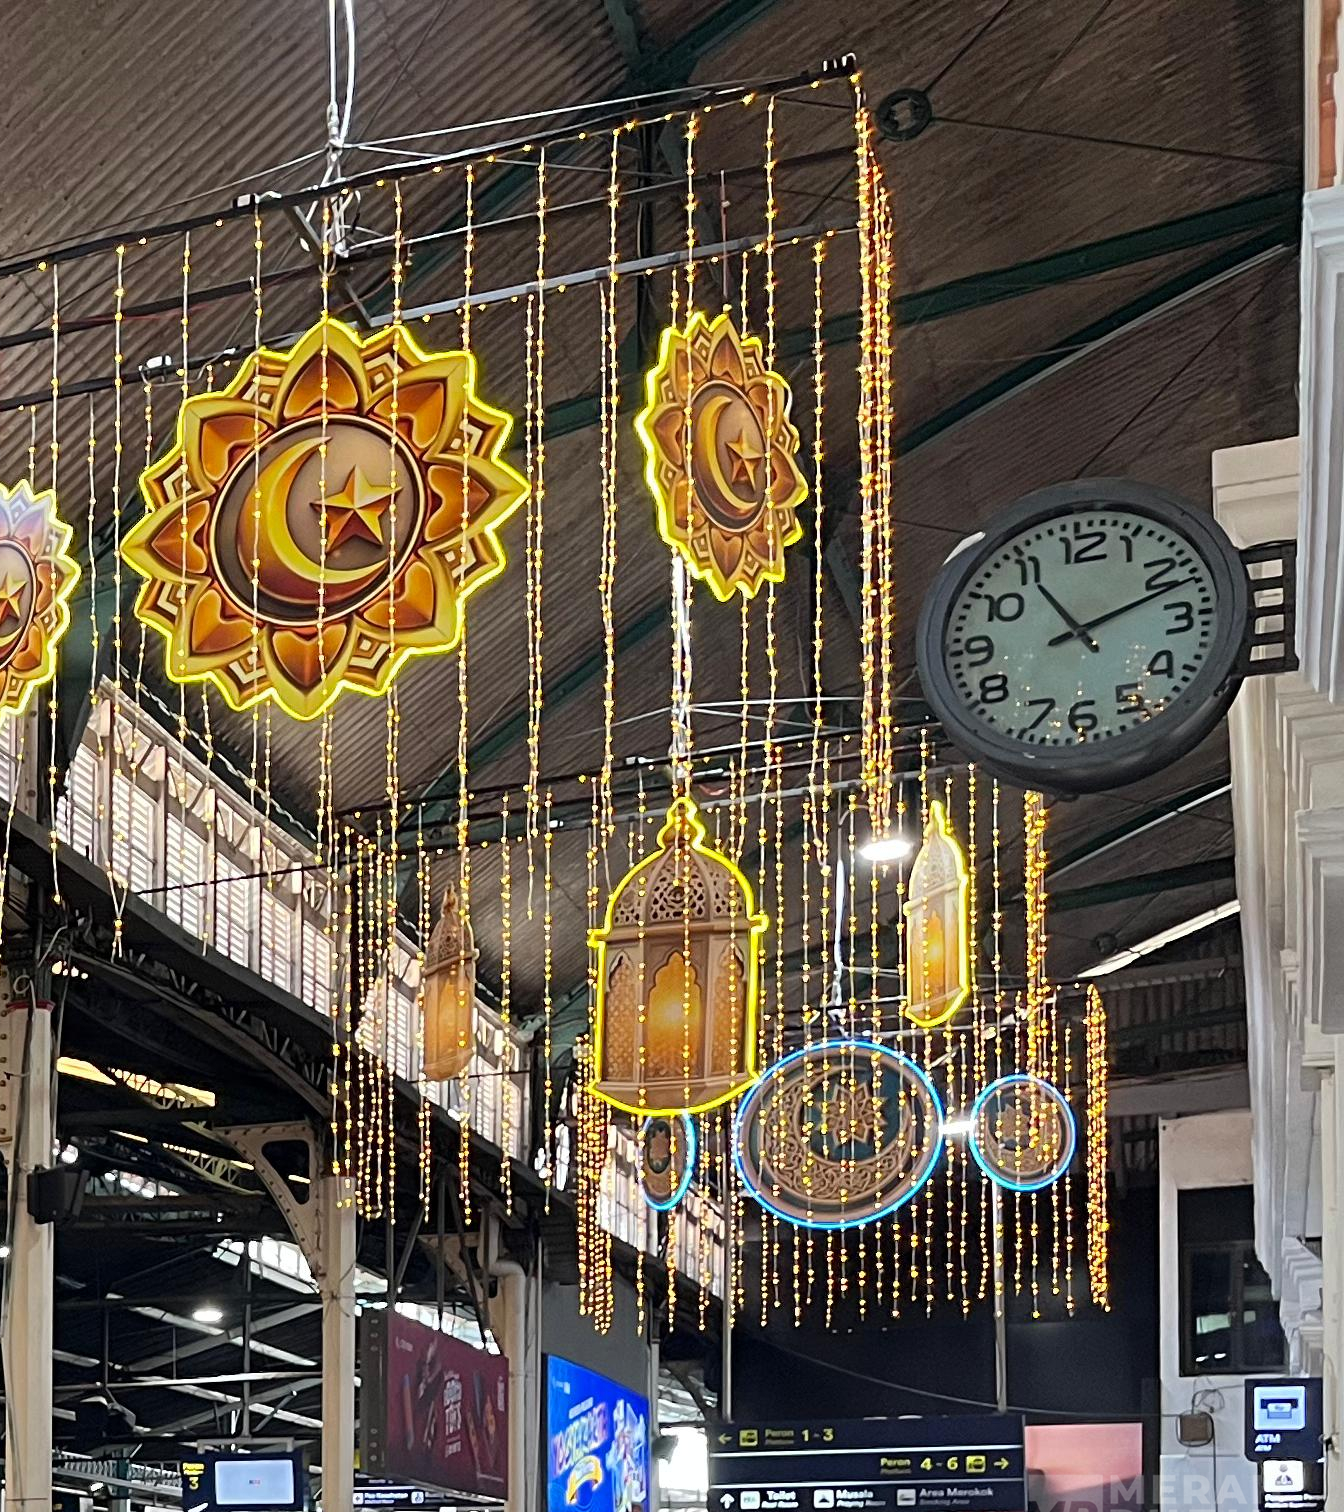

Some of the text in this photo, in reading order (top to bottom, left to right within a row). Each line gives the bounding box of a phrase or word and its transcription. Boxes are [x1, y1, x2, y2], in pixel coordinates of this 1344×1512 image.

[1060, 531, 1108, 564] 12
[1120, 535, 1134, 562] 1
[1015, 556, 1042, 585] 11
[1143, 558, 1180, 591] 2
[983, 592, 1025, 622] 10
[1163, 601, 1194, 635] 3
[964, 635, 994, 667] 9
[1149, 650, 1174, 678] 4
[979, 674, 1009, 704] 8
[1115, 682, 1145, 715] 5
[1027, 698, 1056, 734] 7
[1067, 700, 1098, 732] 6
[801, 1430, 809, 1441] 1
[823, 1429, 834, 1442] 3
[1255, 1434, 1281, 1444] ATM
[920, 1457, 932, 1471] 4
[946, 1457, 959, 1471] 6
[189, 1477, 199, 1490] 3
